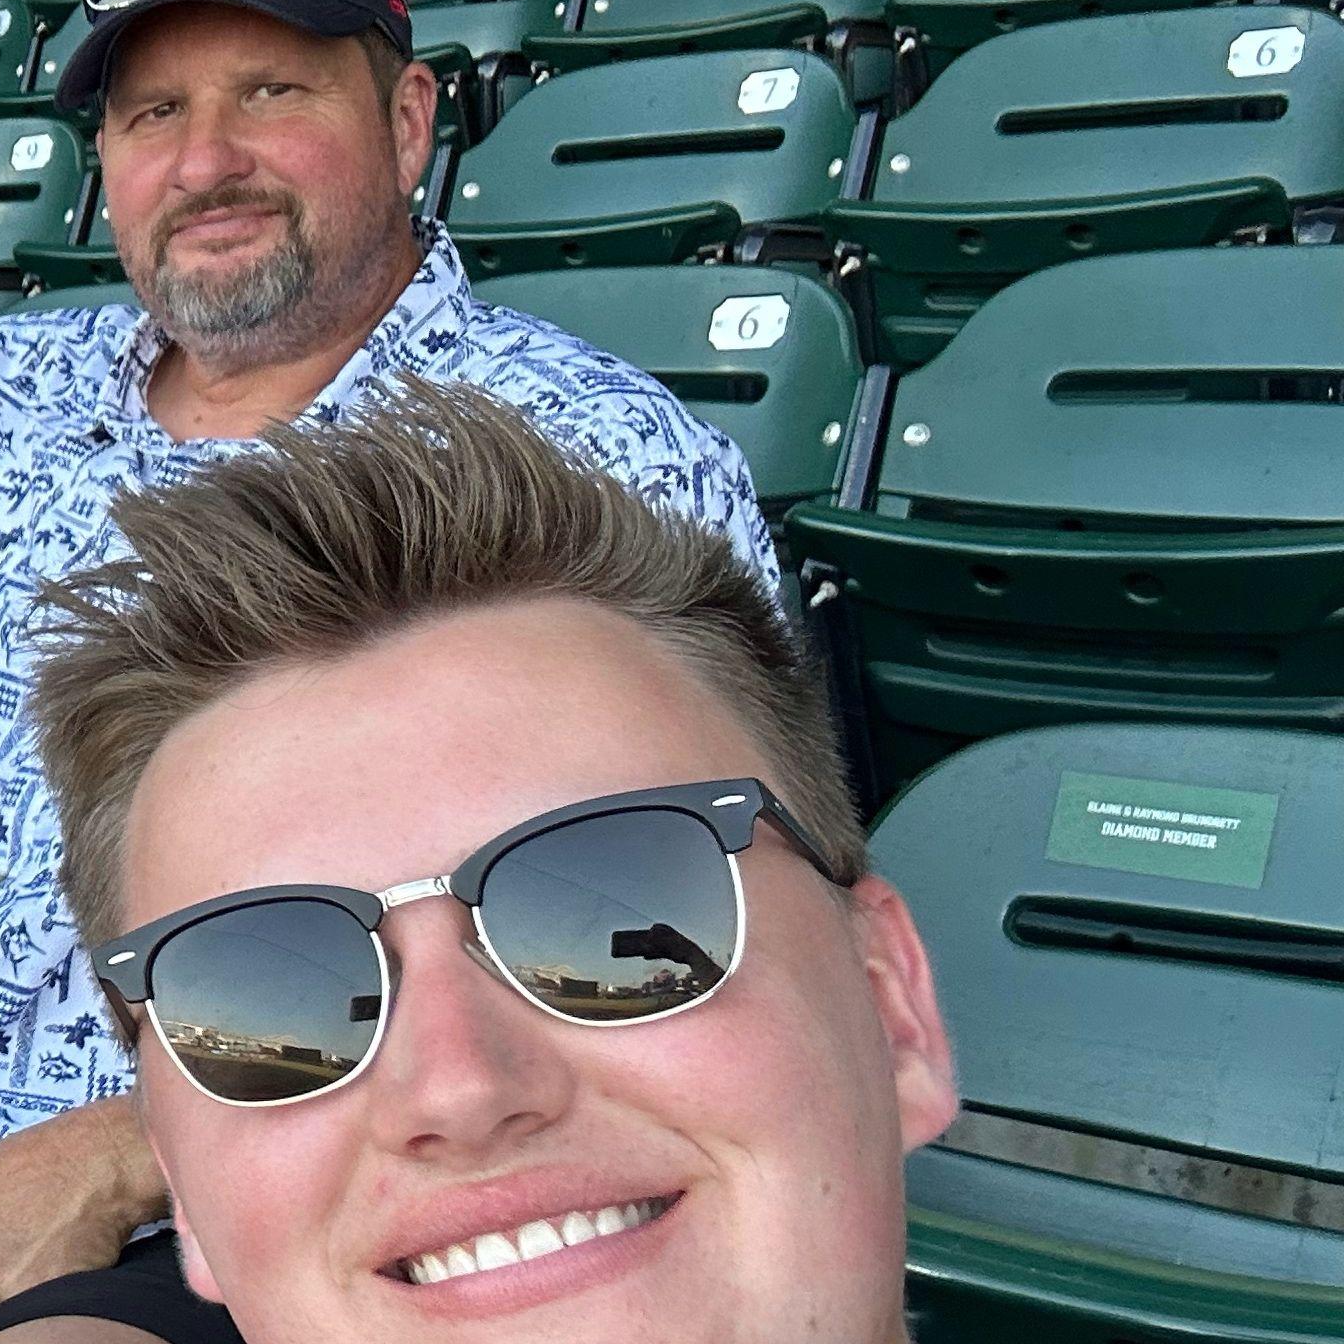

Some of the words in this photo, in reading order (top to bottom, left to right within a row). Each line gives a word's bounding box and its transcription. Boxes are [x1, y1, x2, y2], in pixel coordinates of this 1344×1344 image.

[1255, 35, 1279, 68] 6
[762, 76, 779, 104] 7
[26, 141, 39, 161] 9
[737, 304, 762, 340] 6
[1101, 820, 1162, 843] DIAMOND
[1162, 829, 1218, 850] MEMBER
